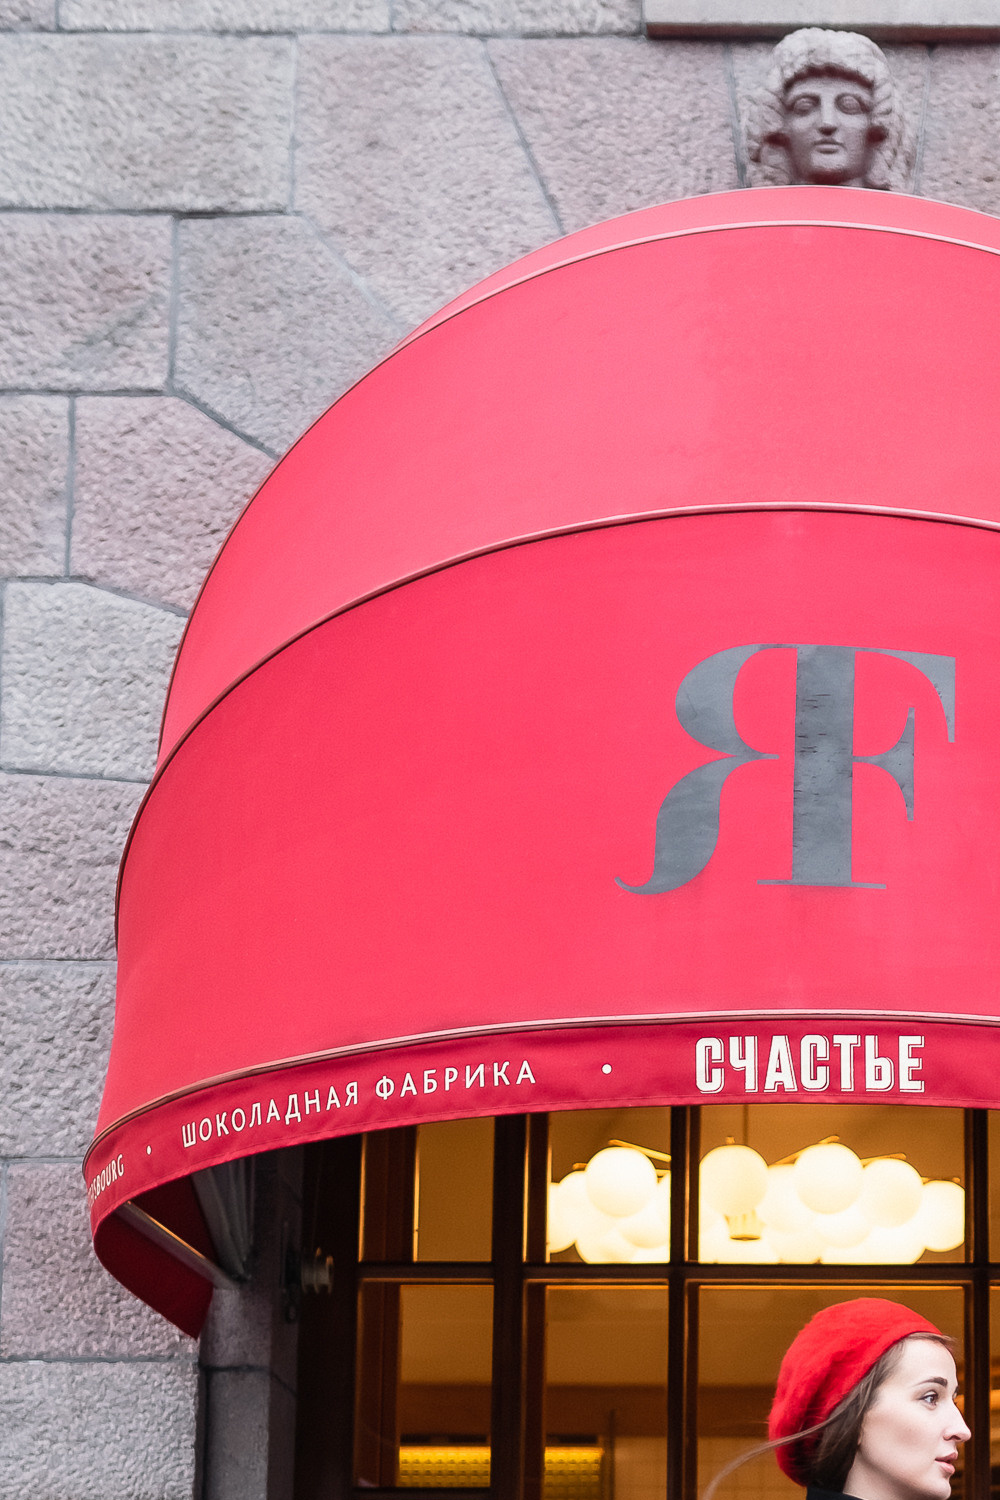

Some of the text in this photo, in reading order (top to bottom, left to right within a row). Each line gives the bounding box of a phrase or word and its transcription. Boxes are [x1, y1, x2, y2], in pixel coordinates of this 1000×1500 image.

[695, 1034, 925, 1094] СЧАСТЬЕ
[181, 1060, 536, 1148] ШОКОЛАДНАЯ ФАБРИКА
